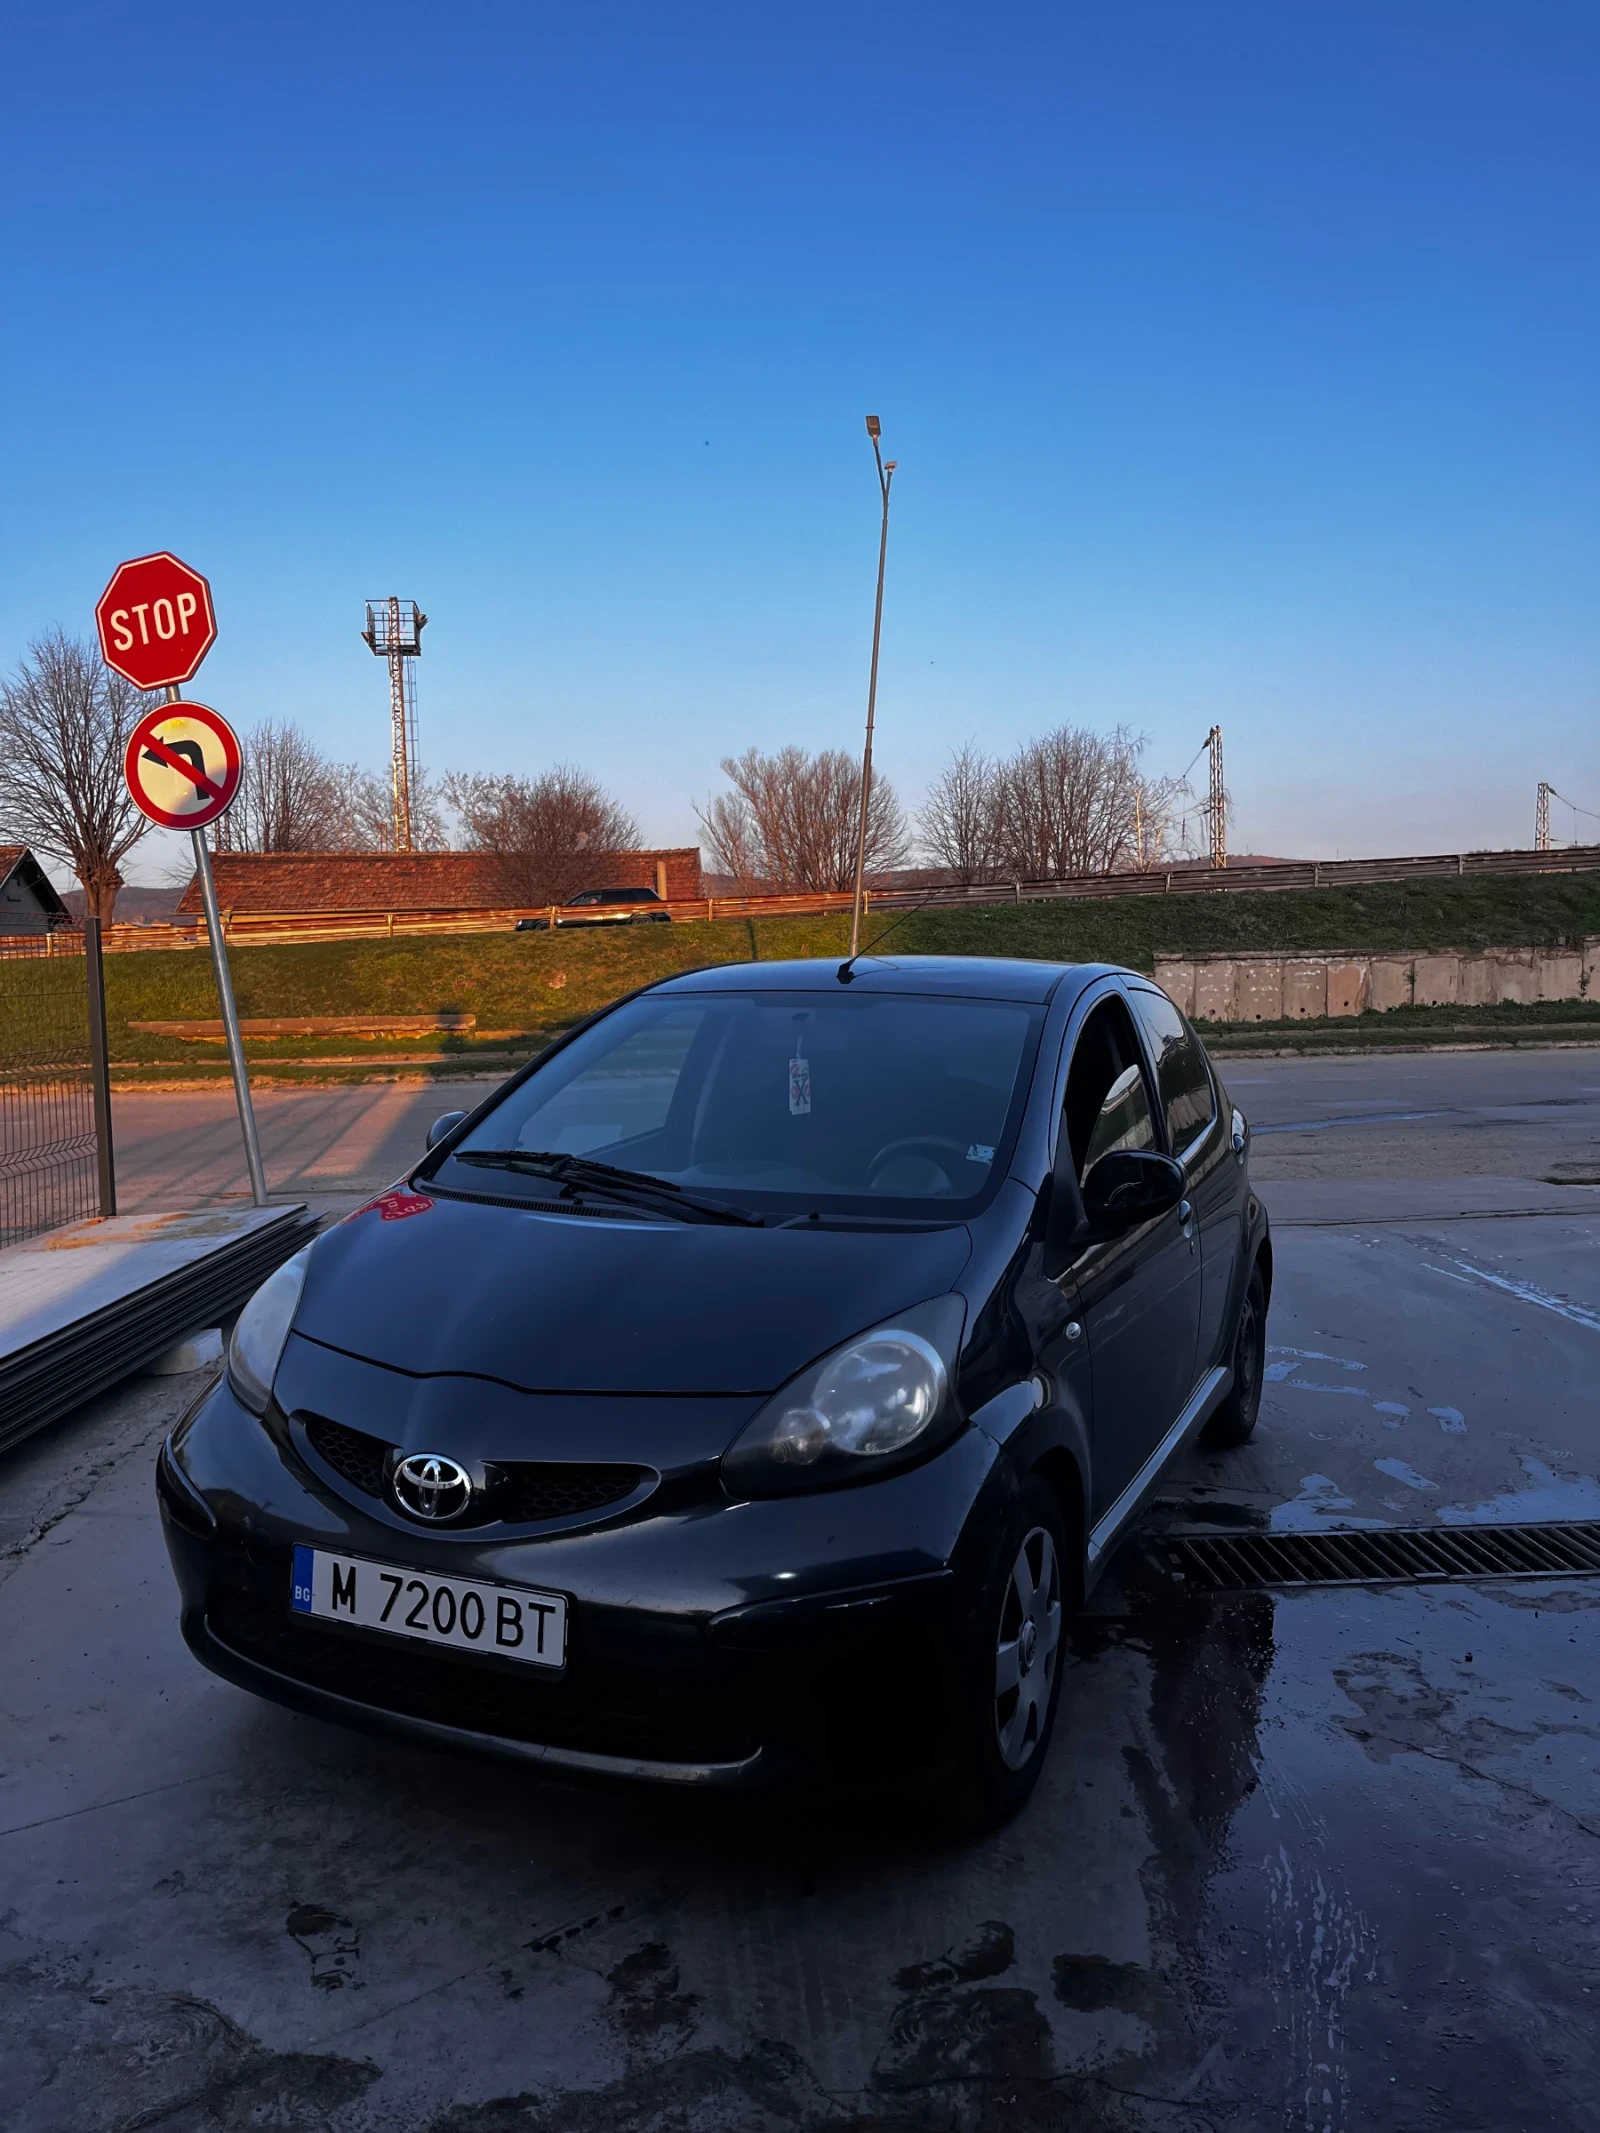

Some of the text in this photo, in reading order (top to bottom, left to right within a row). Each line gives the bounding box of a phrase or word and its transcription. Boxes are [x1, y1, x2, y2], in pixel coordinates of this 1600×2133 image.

[110, 592, 197, 651] STOP
[294, 1585, 311, 1602] BG
[331, 1561, 357, 1615] M
